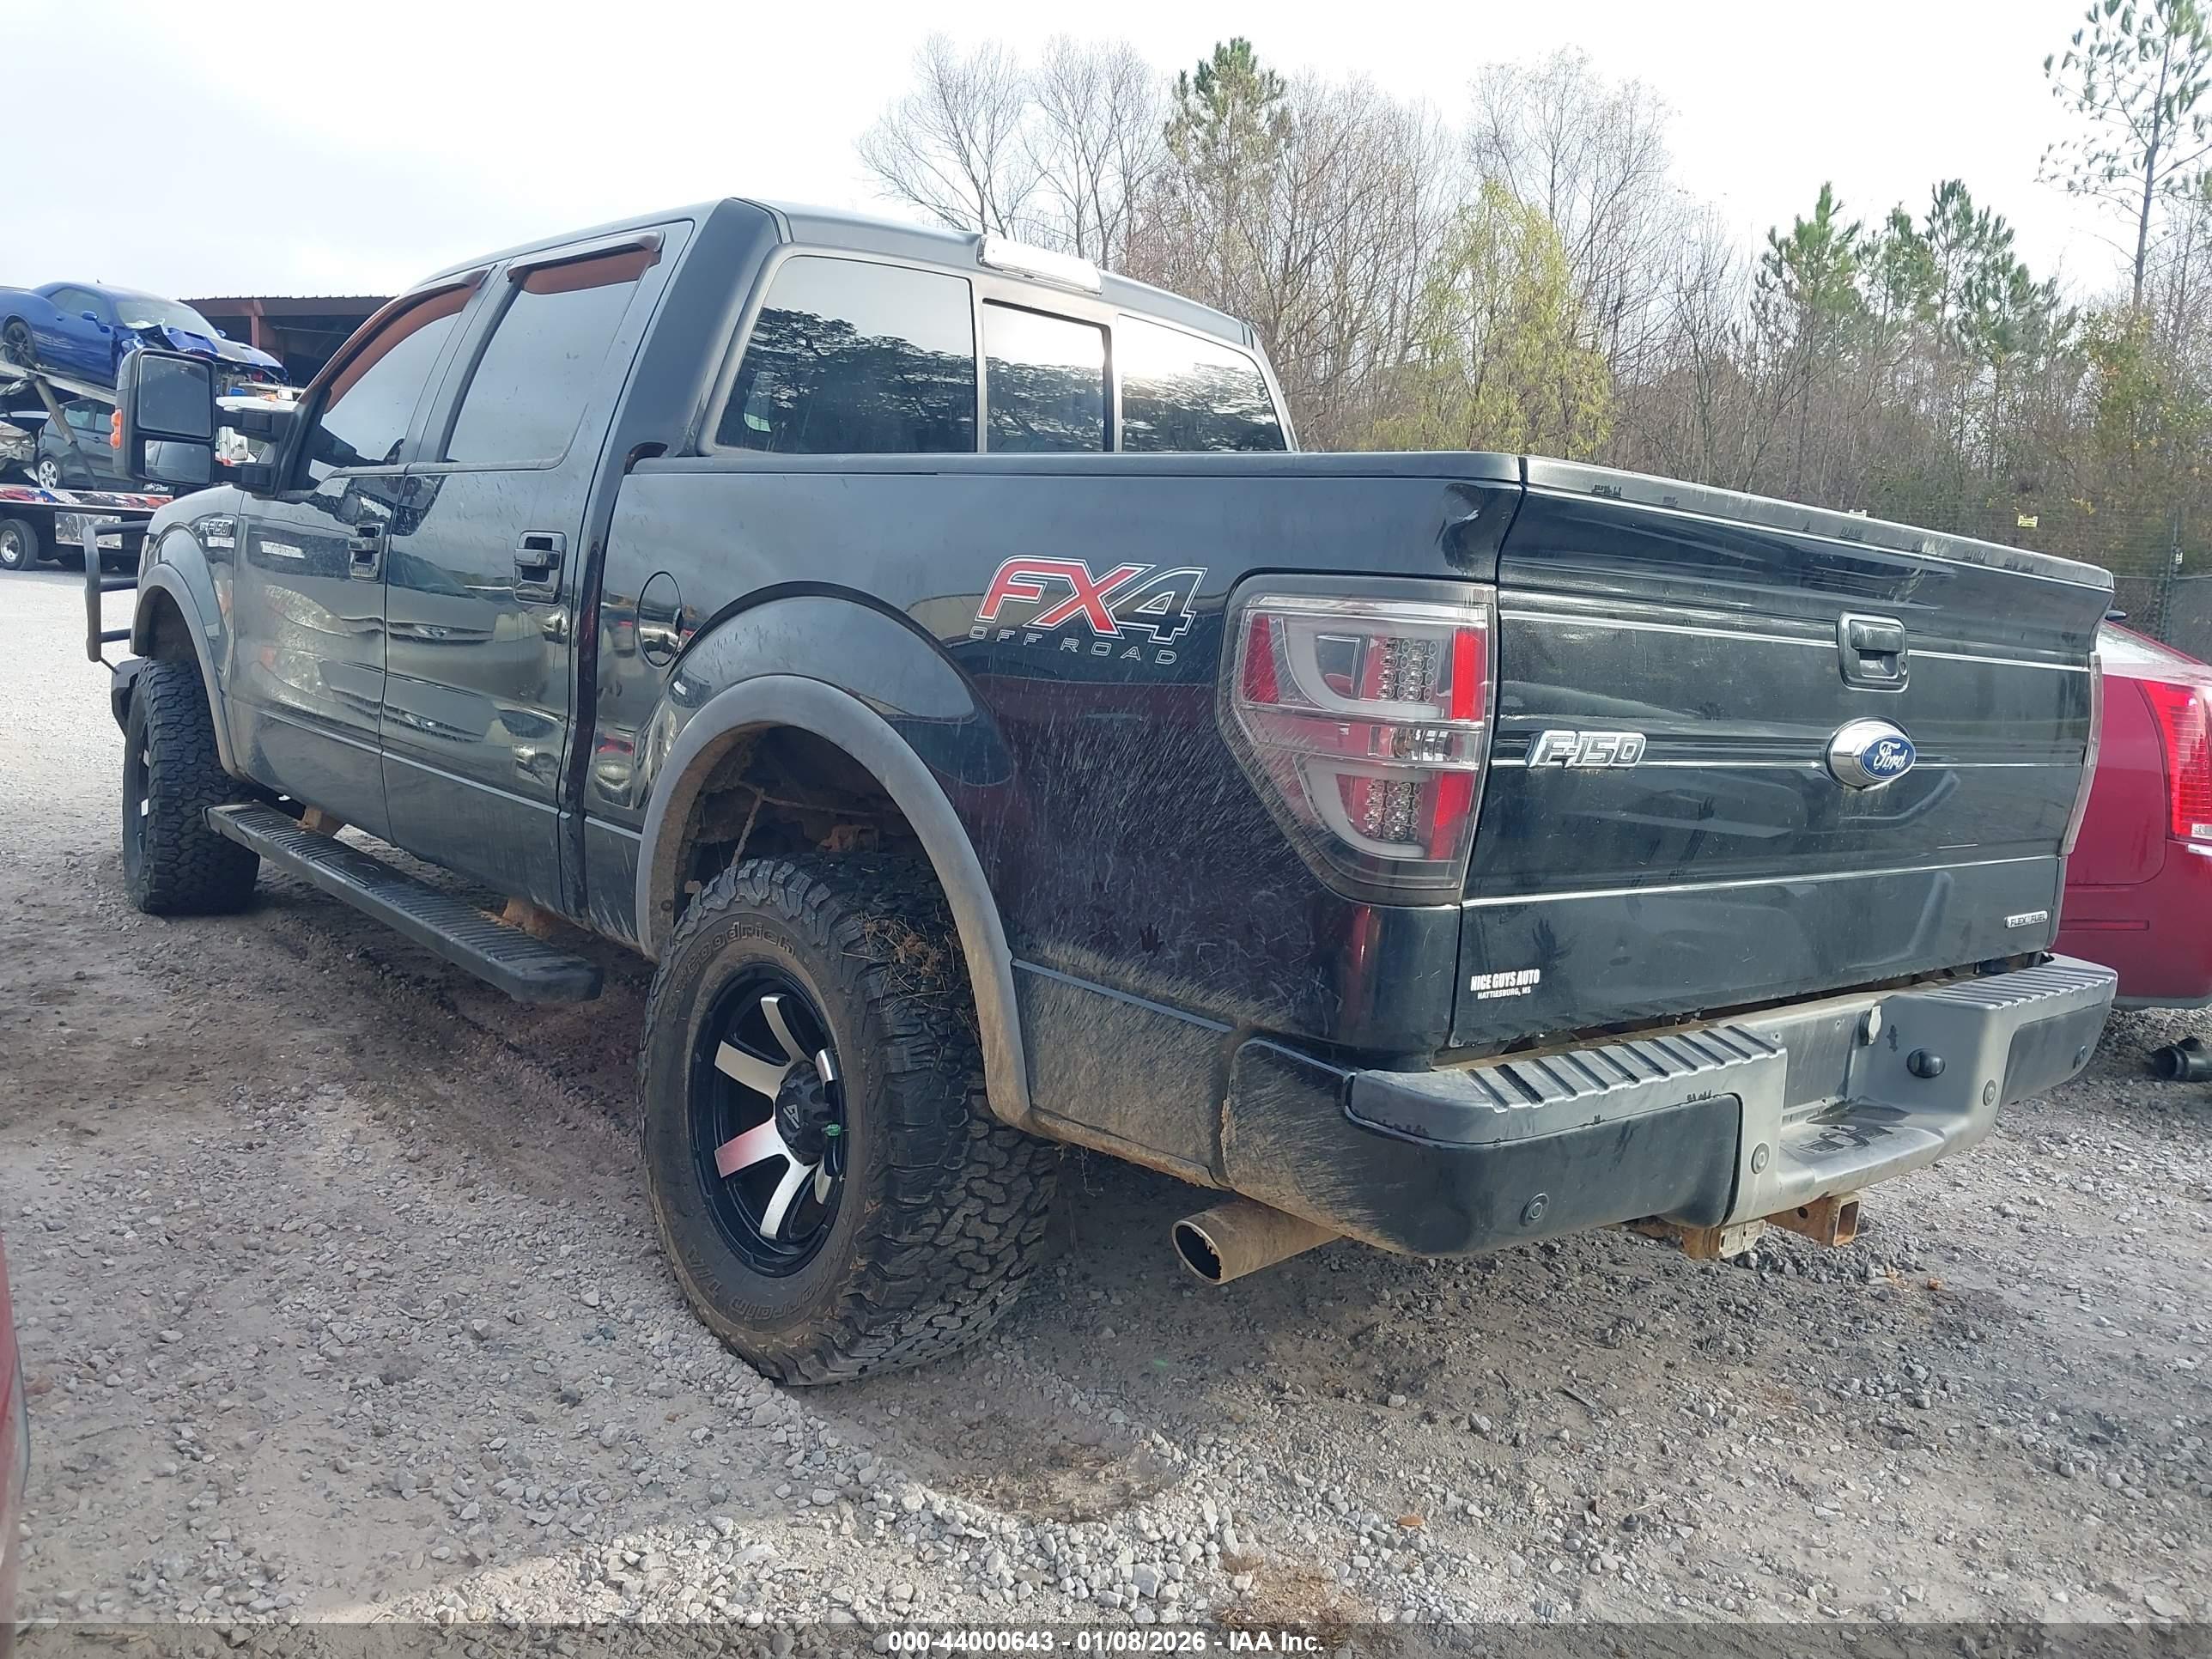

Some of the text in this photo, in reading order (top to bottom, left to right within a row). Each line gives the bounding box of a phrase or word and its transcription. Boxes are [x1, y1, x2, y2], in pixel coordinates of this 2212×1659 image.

[975, 555, 1208, 646] FX4
[969, 626, 1177, 665] OFF ROAD
[1873, 741, 1908, 770] Ford
[1470, 969, 1540, 992] NICE GUYS AUTO
[1522, 986, 1532, 994] MS
